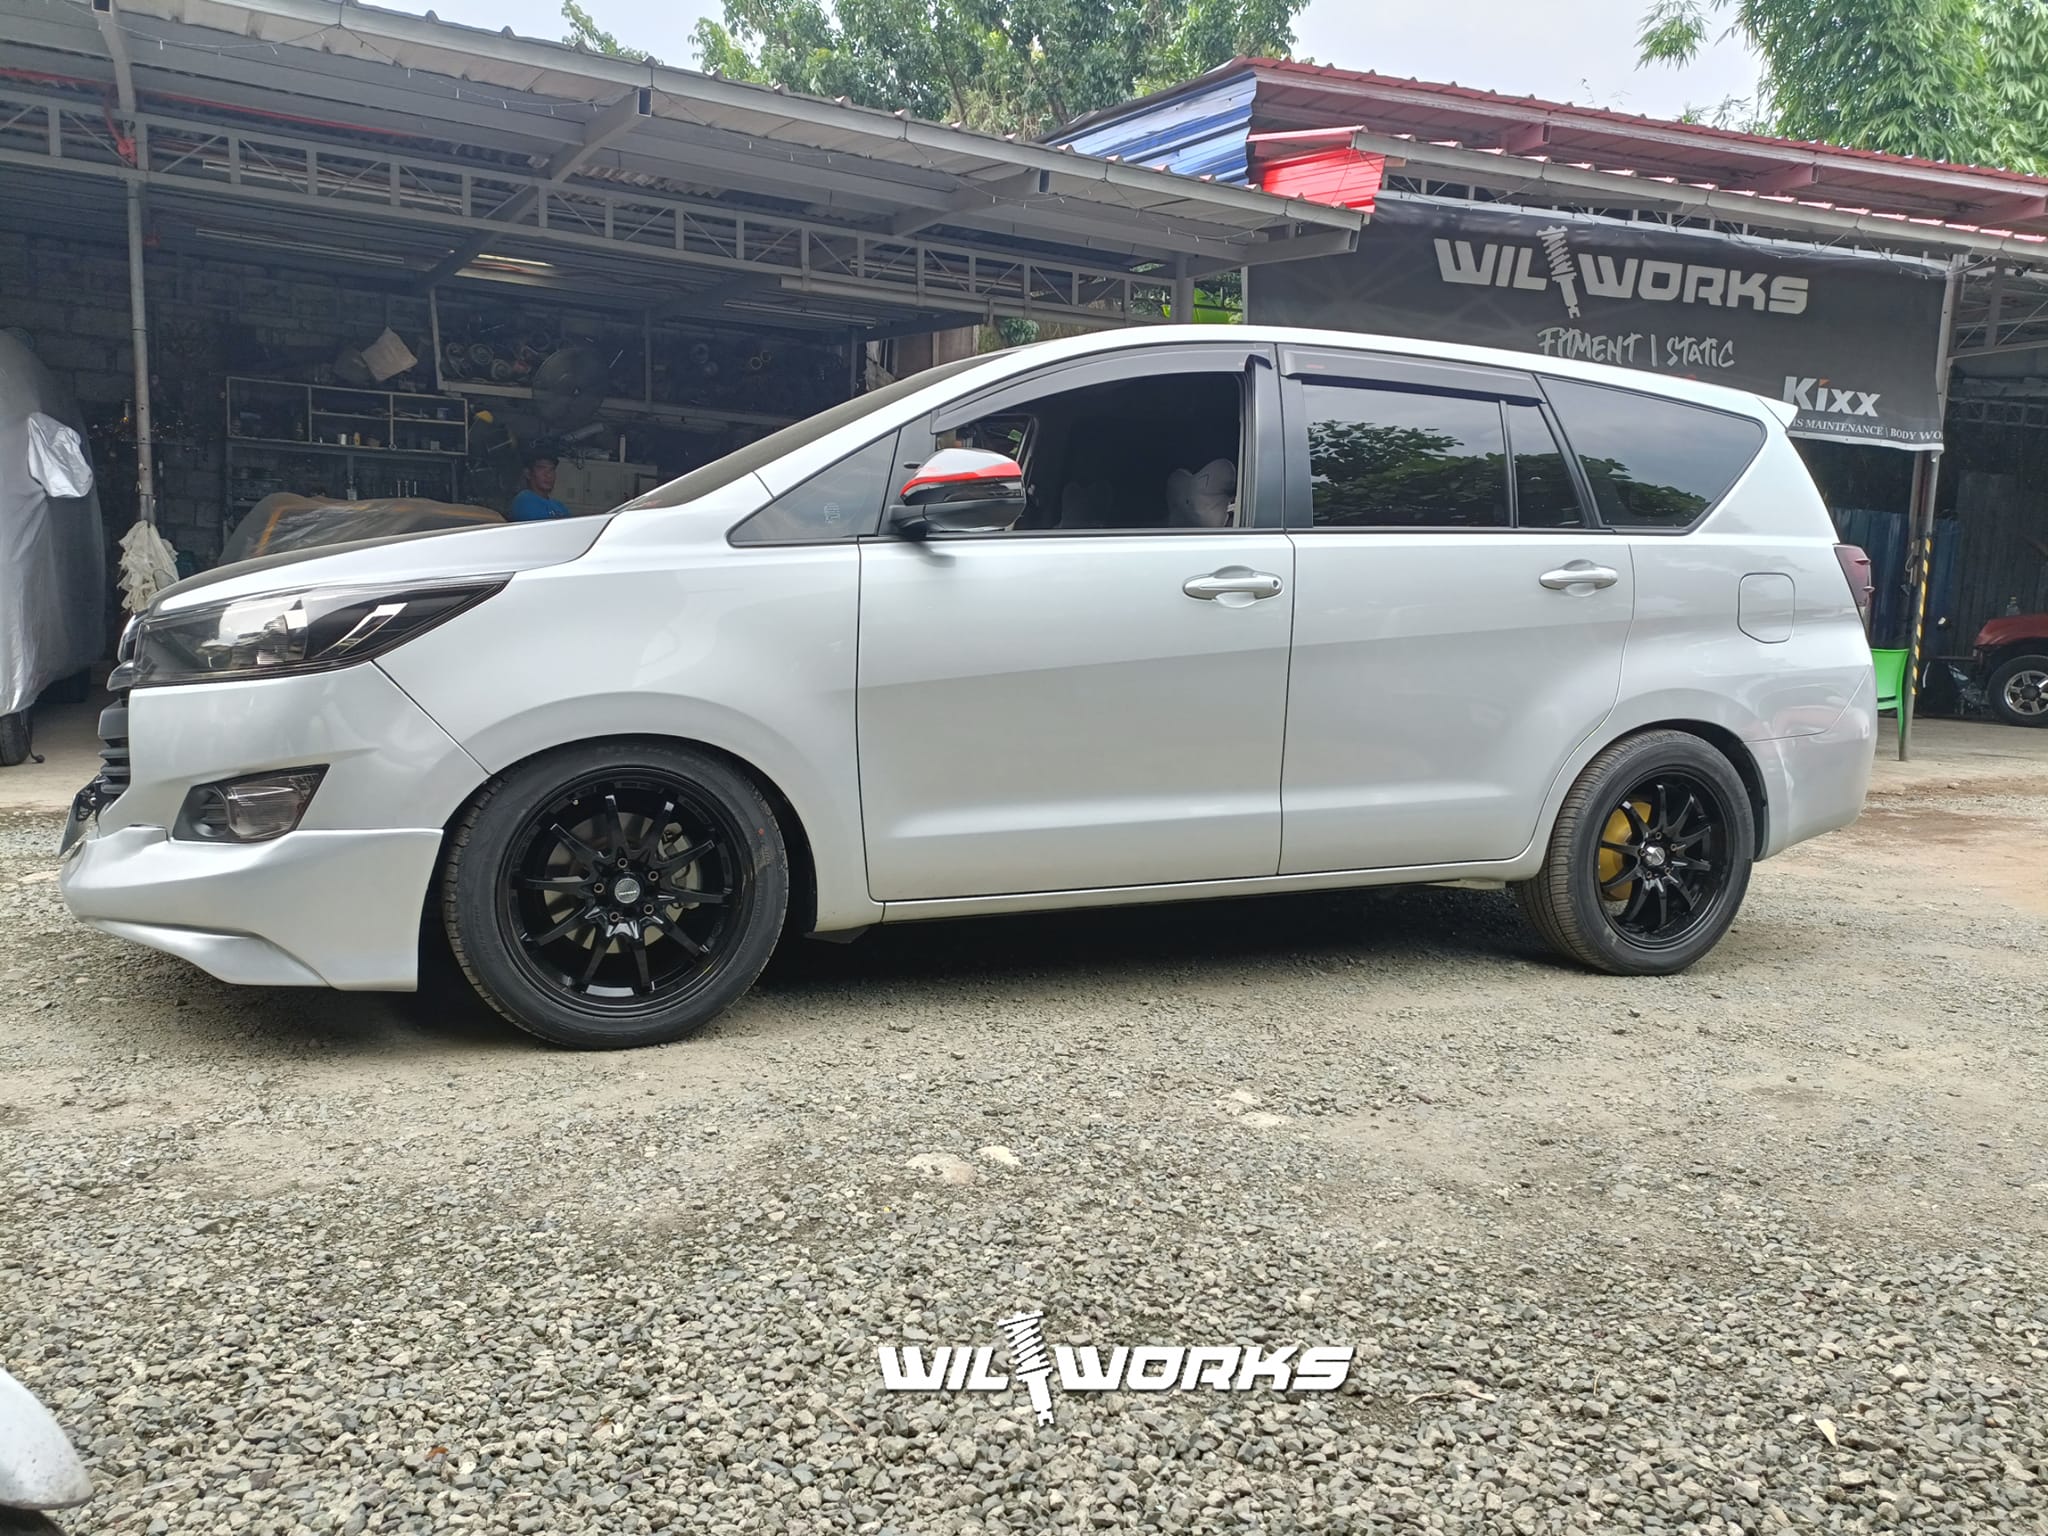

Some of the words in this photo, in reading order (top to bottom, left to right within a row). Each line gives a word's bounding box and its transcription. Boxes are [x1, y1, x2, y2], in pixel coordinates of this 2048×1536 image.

[1434, 238, 1547, 291] WIL
[1577, 253, 1809, 315] WORKS
[1783, 376, 1881, 417] Kixx
[1805, 419, 1884, 436] MAINTENANCE
[1890, 428, 1917, 440] BODY
[1919, 430, 1943, 440] WO
